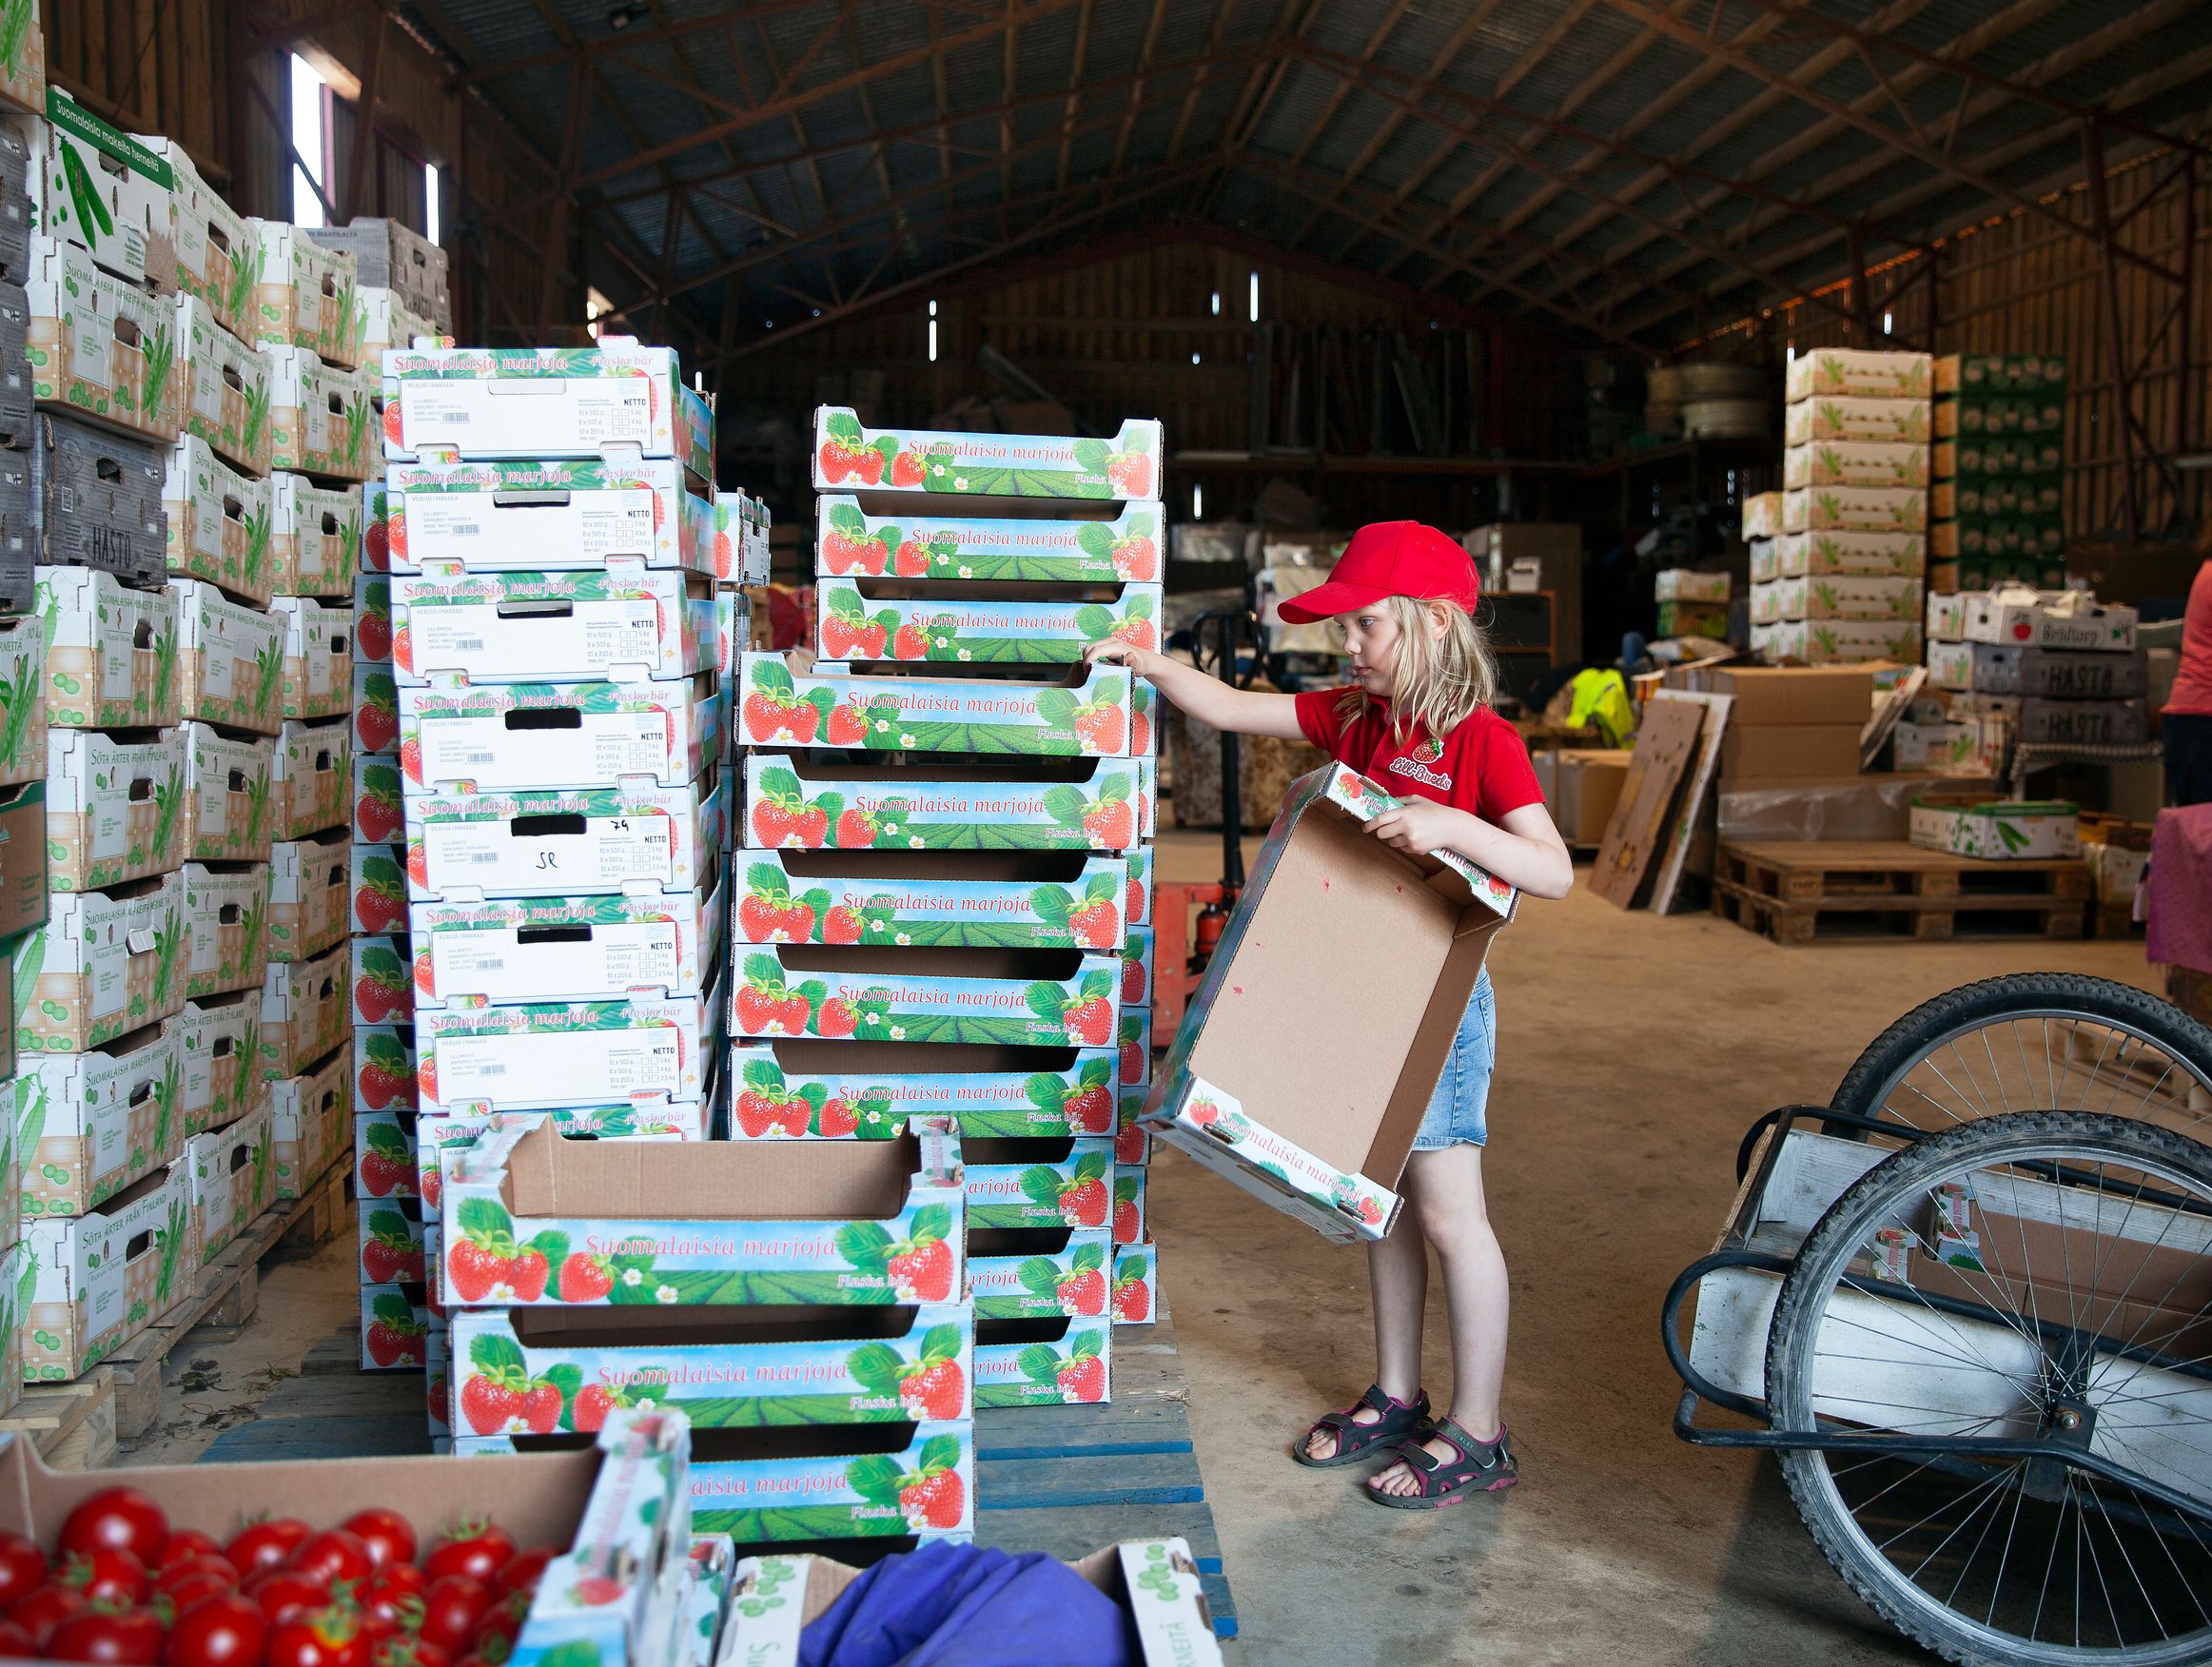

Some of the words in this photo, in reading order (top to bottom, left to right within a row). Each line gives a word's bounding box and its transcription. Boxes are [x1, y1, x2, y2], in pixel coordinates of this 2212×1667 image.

[56, 100, 101, 138] Suomalaisia
[102, 128, 130, 155] makeita
[131, 147, 160, 173] herneitä
[395, 356, 498, 371] Suomalaisia
[503, 357, 567, 370] marjoja
[624, 398, 646, 406] NETTO
[909, 441, 1007, 459] Suomalaisia
[1013, 446, 1073, 462] marjoja
[400, 469, 500, 484] Suomalaisia
[507, 469, 571, 483] marjoja
[912, 530, 1010, 546] Suomalaisia
[1016, 533, 1078, 549] marjoja
[404, 582, 506, 598] Suomalaisia
[511, 581, 575, 597] marjoja
[910, 612, 1009, 630] Suomalaisia
[1014, 617, 1077, 632] marjoja
[27, 625, 35, 639] 10
[414, 695, 517, 711] Suomalaisia
[520, 693, 585, 709] marjoja
[847, 692, 960, 713] Suomalaisia
[966, 697, 1037, 716] marjoja
[1037, 728, 1073, 741] Finska
[1075, 729, 1095, 740] bär
[1390, 757, 1452, 791] Lill-Breds
[418, 799, 519, 814] Suomalaisia
[524, 797, 589, 813] marjoja
[855, 795, 969, 814] Suomalaisia
[974, 798, 1045, 815] marjoja
[1046, 827, 1081, 839] Finska
[1083, 827, 1103, 839] bär
[842, 892, 954, 912] Suomalaisia
[961, 896, 1031, 912] marjoja
[426, 908, 528, 923] Suomalaisia
[532, 904, 596, 919] marjoja
[1030, 926, 1067, 938] Finska
[1069, 926, 1087, 937] bär
[838, 985, 949, 1004] Suomalaisia
[956, 991, 1026, 1009] marjoja
[430, 1014, 530, 1030] Suomalaisia
[535, 1010, 598, 1026] marjoja
[1025, 1021, 1061, 1032] Finska
[1063, 1022, 1083, 1032] bär
[86, 1064, 128, 1088] SUOMALAISIA
[839, 1085, 950, 1101] Suomalaisia
[956, 1086, 1026, 1102] marjoja
[556, 1118, 603, 1133] arjoja
[1027, 1112, 1062, 1123] Finska
[1064, 1111, 1083, 1123] bär
[1221, 1112, 1303, 1170] Suomalaisia
[1305, 1165, 1359, 1202] marjoja
[968, 1179, 1020, 1195] arjoja
[1021, 1206, 1057, 1217] Finska
[1060, 1206, 1077, 1217] bär
[82, 1231, 102, 1249] SÖTA
[104, 1218, 125, 1238] ÄRTER
[126, 1206, 142, 1226] FRÅN
[142, 1192, 167, 1217] FINLAND
[586, 1235, 735, 1256] Suomalaisia
[744, 1238, 836, 1258] marjoja
[837, 1274, 884, 1287] Finska
[888, 1274, 913, 1287] bär
[971, 1270, 1018, 1288] rjoja
[1020, 1297, 1054, 1308] Finska
[598, 1363, 748, 1386] Suomalaisia
[754, 1362, 848, 1383] marjoja
[974, 1359, 1018, 1376] rjoja
[1020, 1384, 1054, 1396] Finska
[850, 1396, 895, 1409] Finska
[899, 1395, 924, 1407] bär
[756, 1472, 848, 1495] marjoja
[851, 1503, 897, 1517] Finska
[900, 1502, 925, 1516] bär
